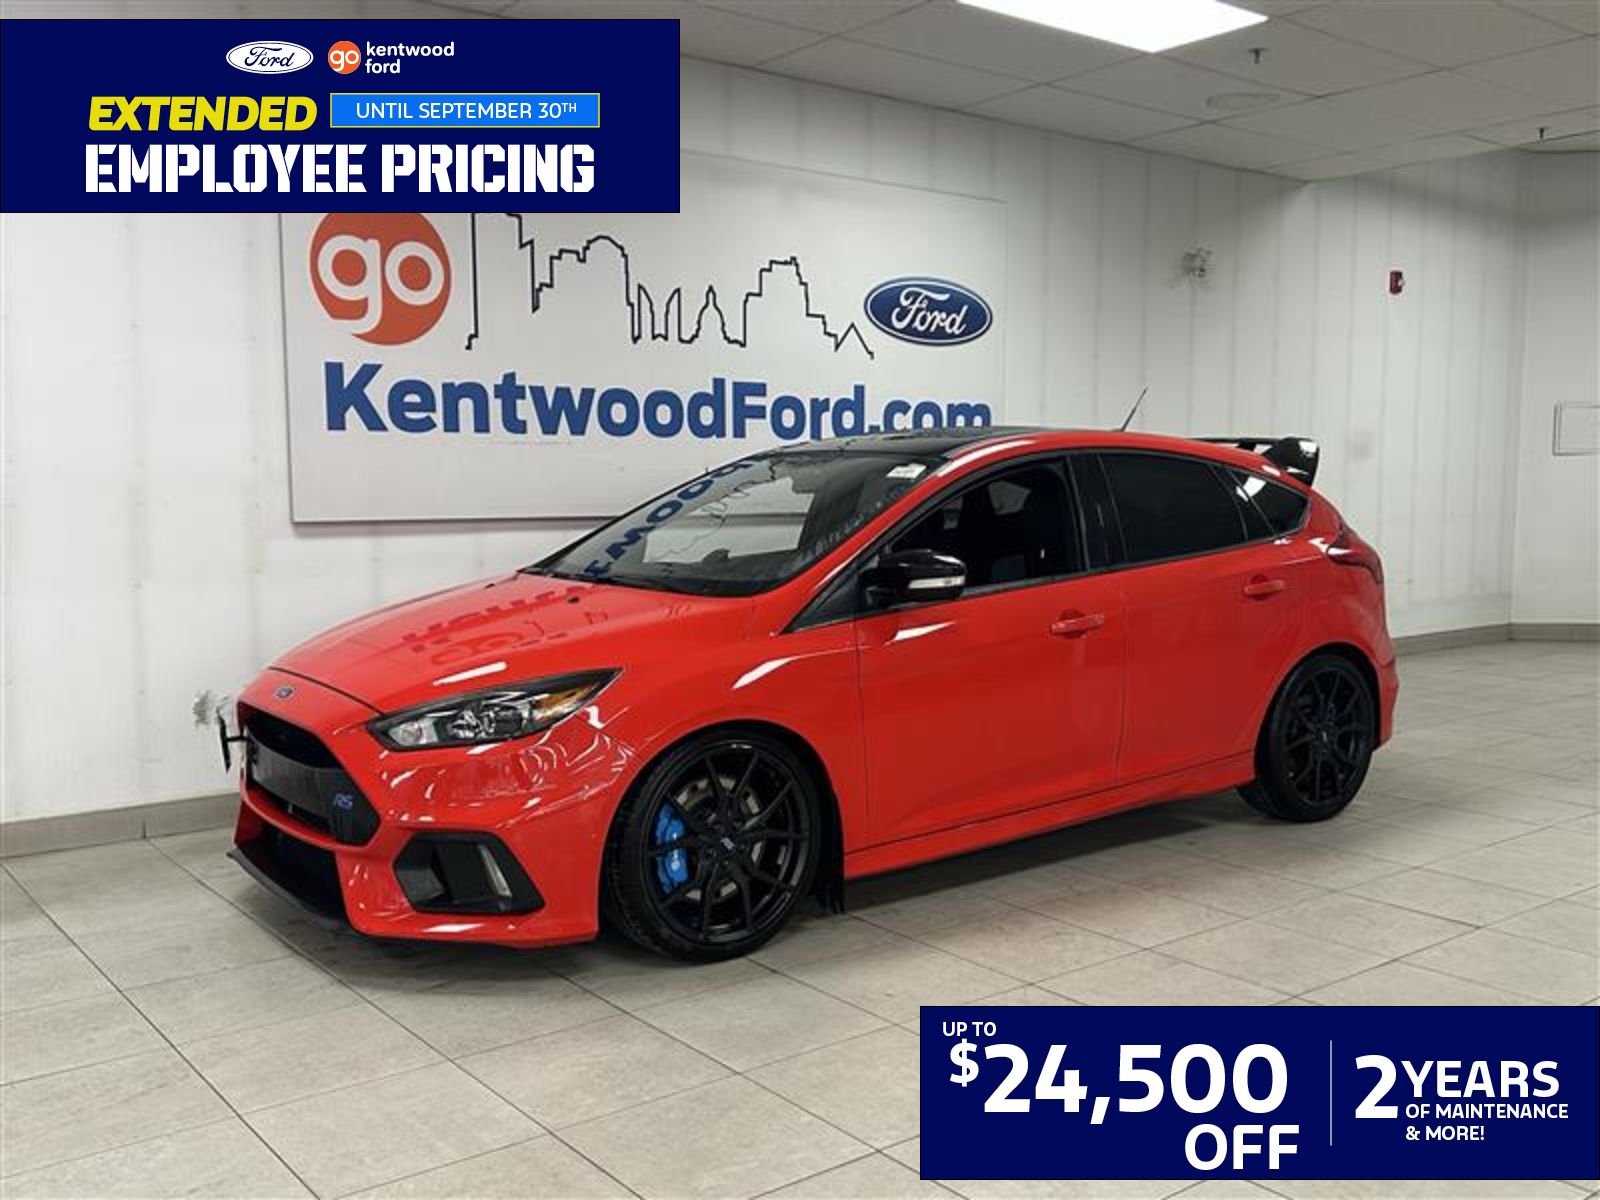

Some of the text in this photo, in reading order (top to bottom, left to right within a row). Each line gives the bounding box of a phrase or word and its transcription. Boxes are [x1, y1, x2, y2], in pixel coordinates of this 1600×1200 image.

[317, 234, 446, 338] go
[890, 286, 967, 336] Ford
[324, 361, 993, 441] KentwoodFord.com
